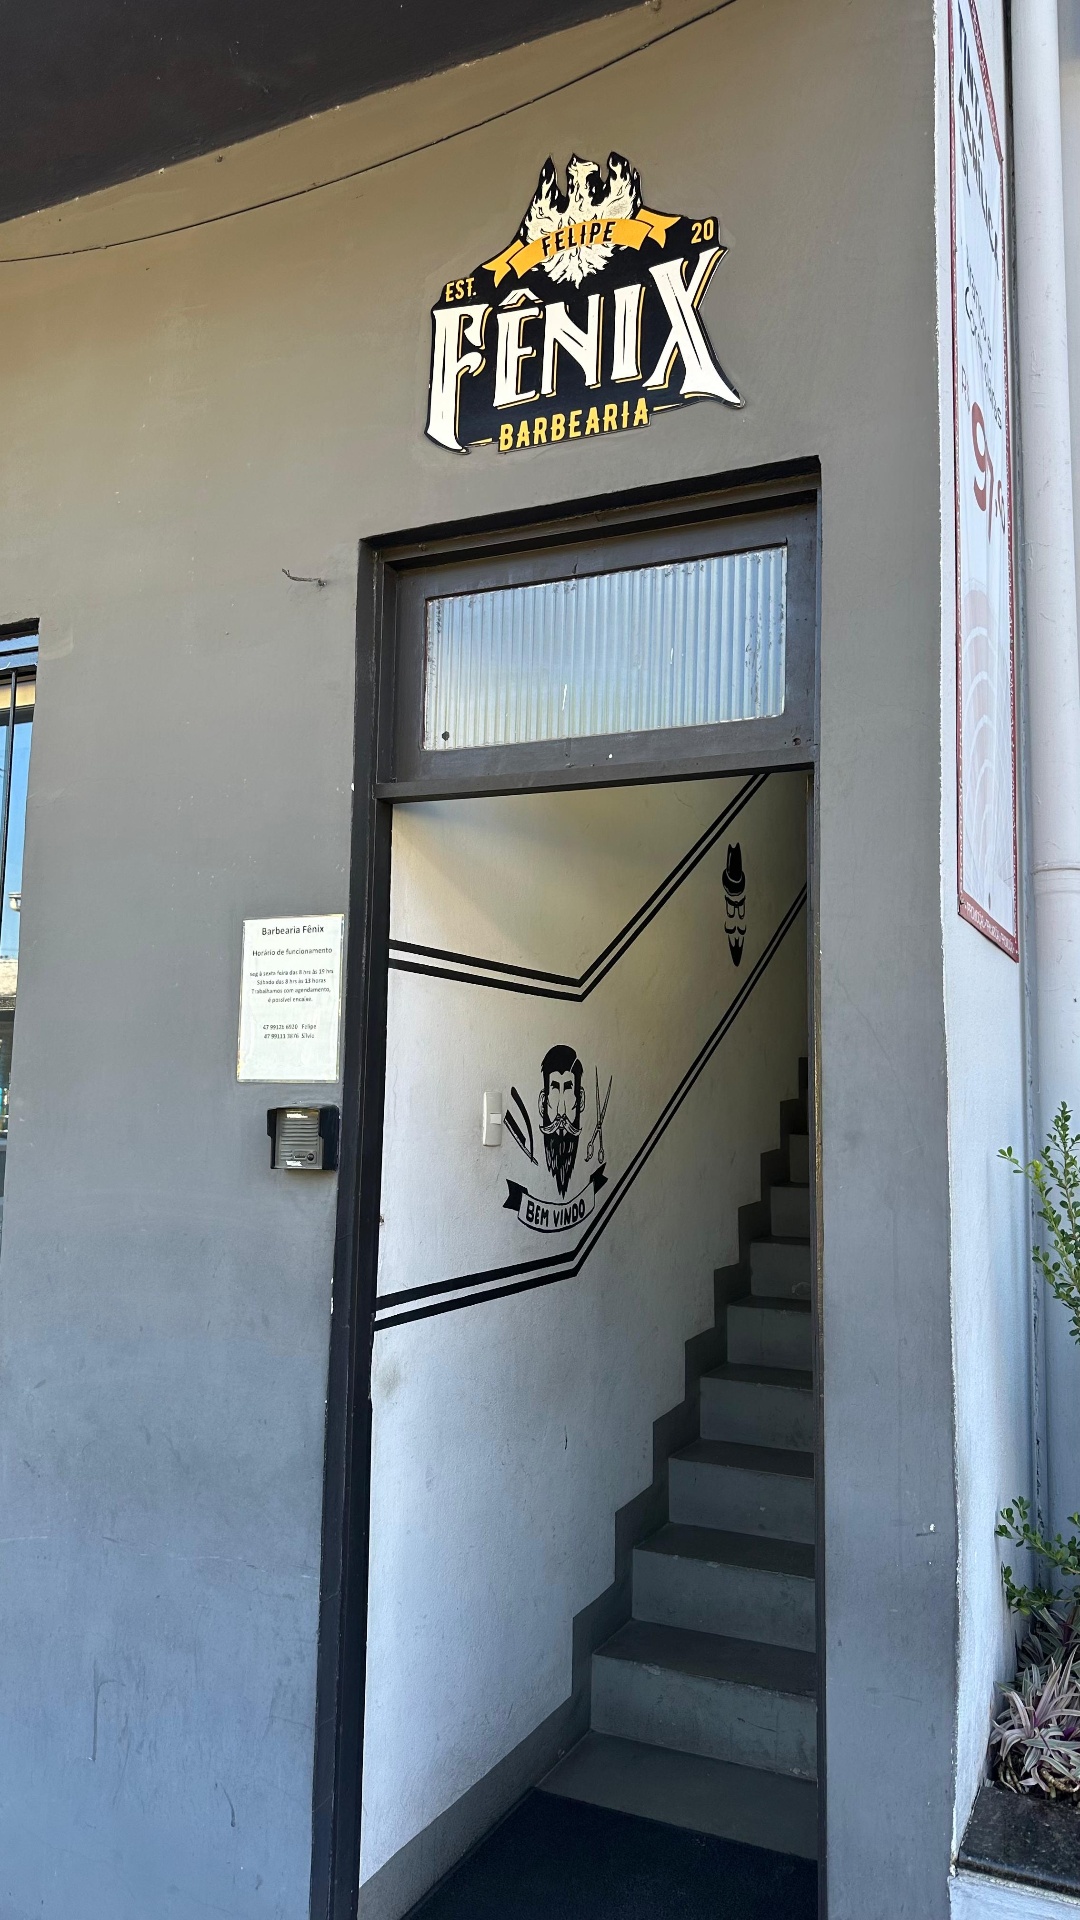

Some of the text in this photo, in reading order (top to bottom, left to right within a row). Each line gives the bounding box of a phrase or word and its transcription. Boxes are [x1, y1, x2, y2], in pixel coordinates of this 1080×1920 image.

[541, 220, 617, 257] FELIPE
[445, 220, 714, 302] EST. 20
[427, 246, 741, 452] FÊNIX
[499, 398, 650, 451] BARBEARIA
[262, 924, 324, 936] Barbearia Fênix
[252, 948, 276, 956] Horário
[286, 948, 332, 956] funcionamento
[526, 1198, 586, 1228] BEM VINDO
